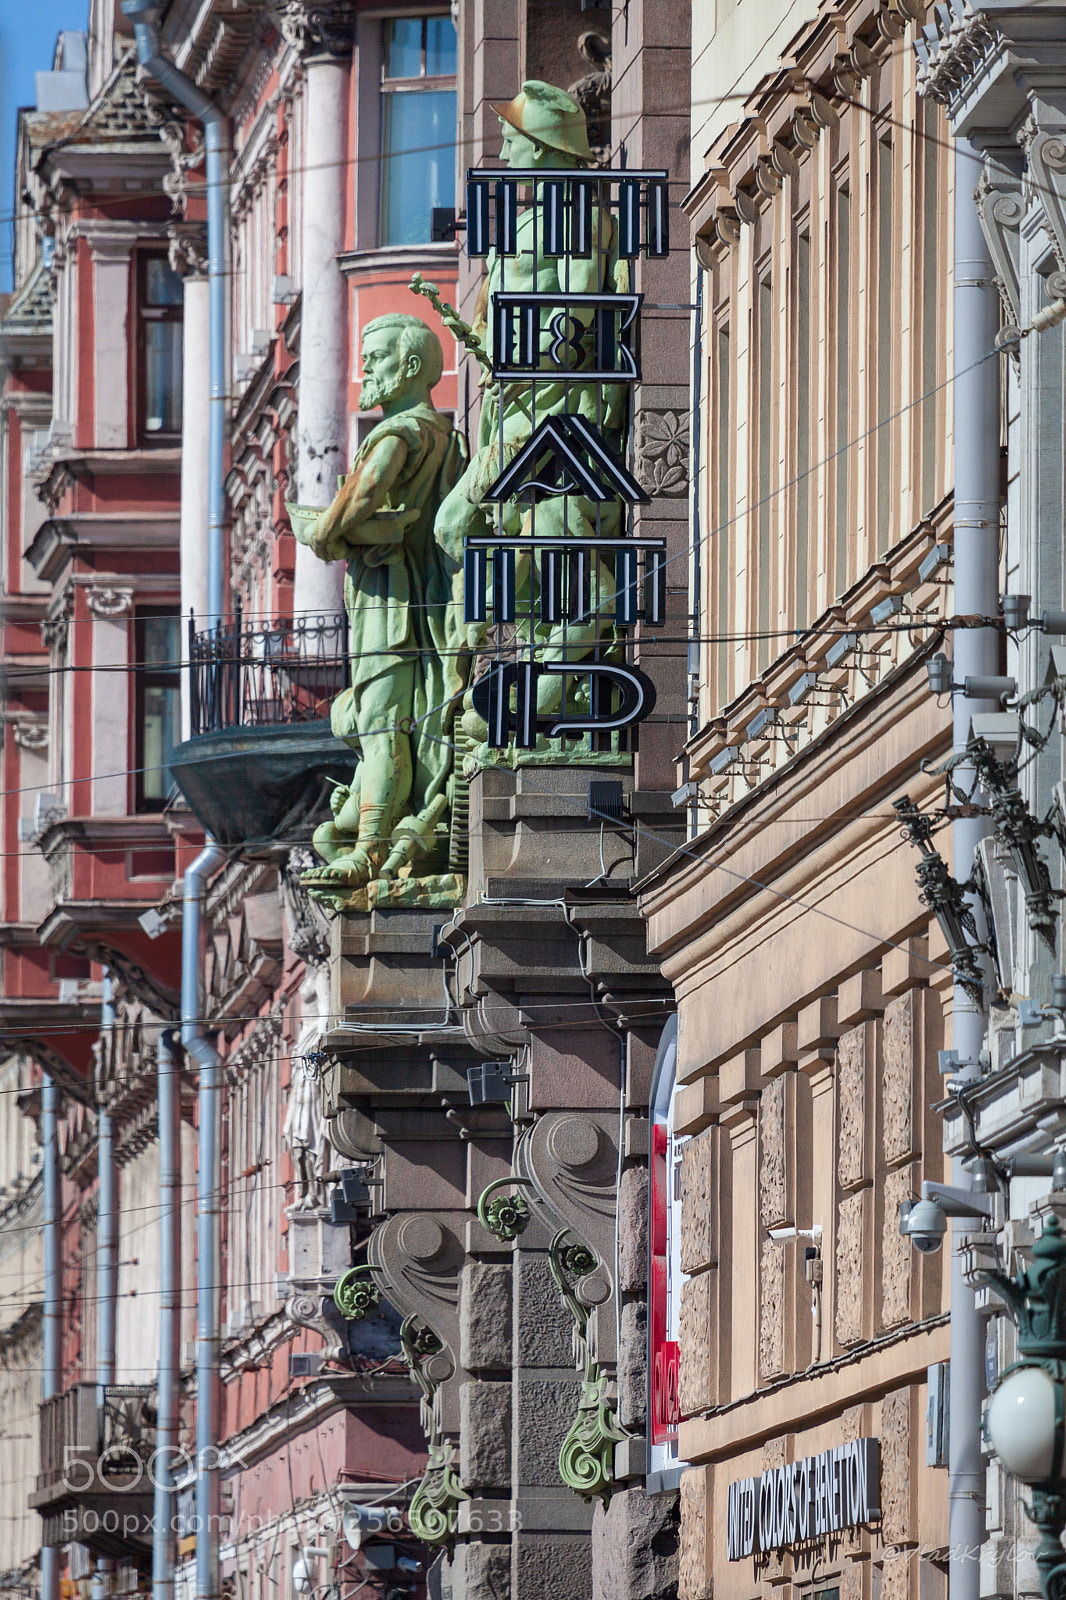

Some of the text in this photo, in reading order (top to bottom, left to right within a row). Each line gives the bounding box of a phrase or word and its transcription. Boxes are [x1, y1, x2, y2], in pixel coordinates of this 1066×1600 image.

[727, 1438, 870, 1561] UNITED COLORS OF BENETTON
